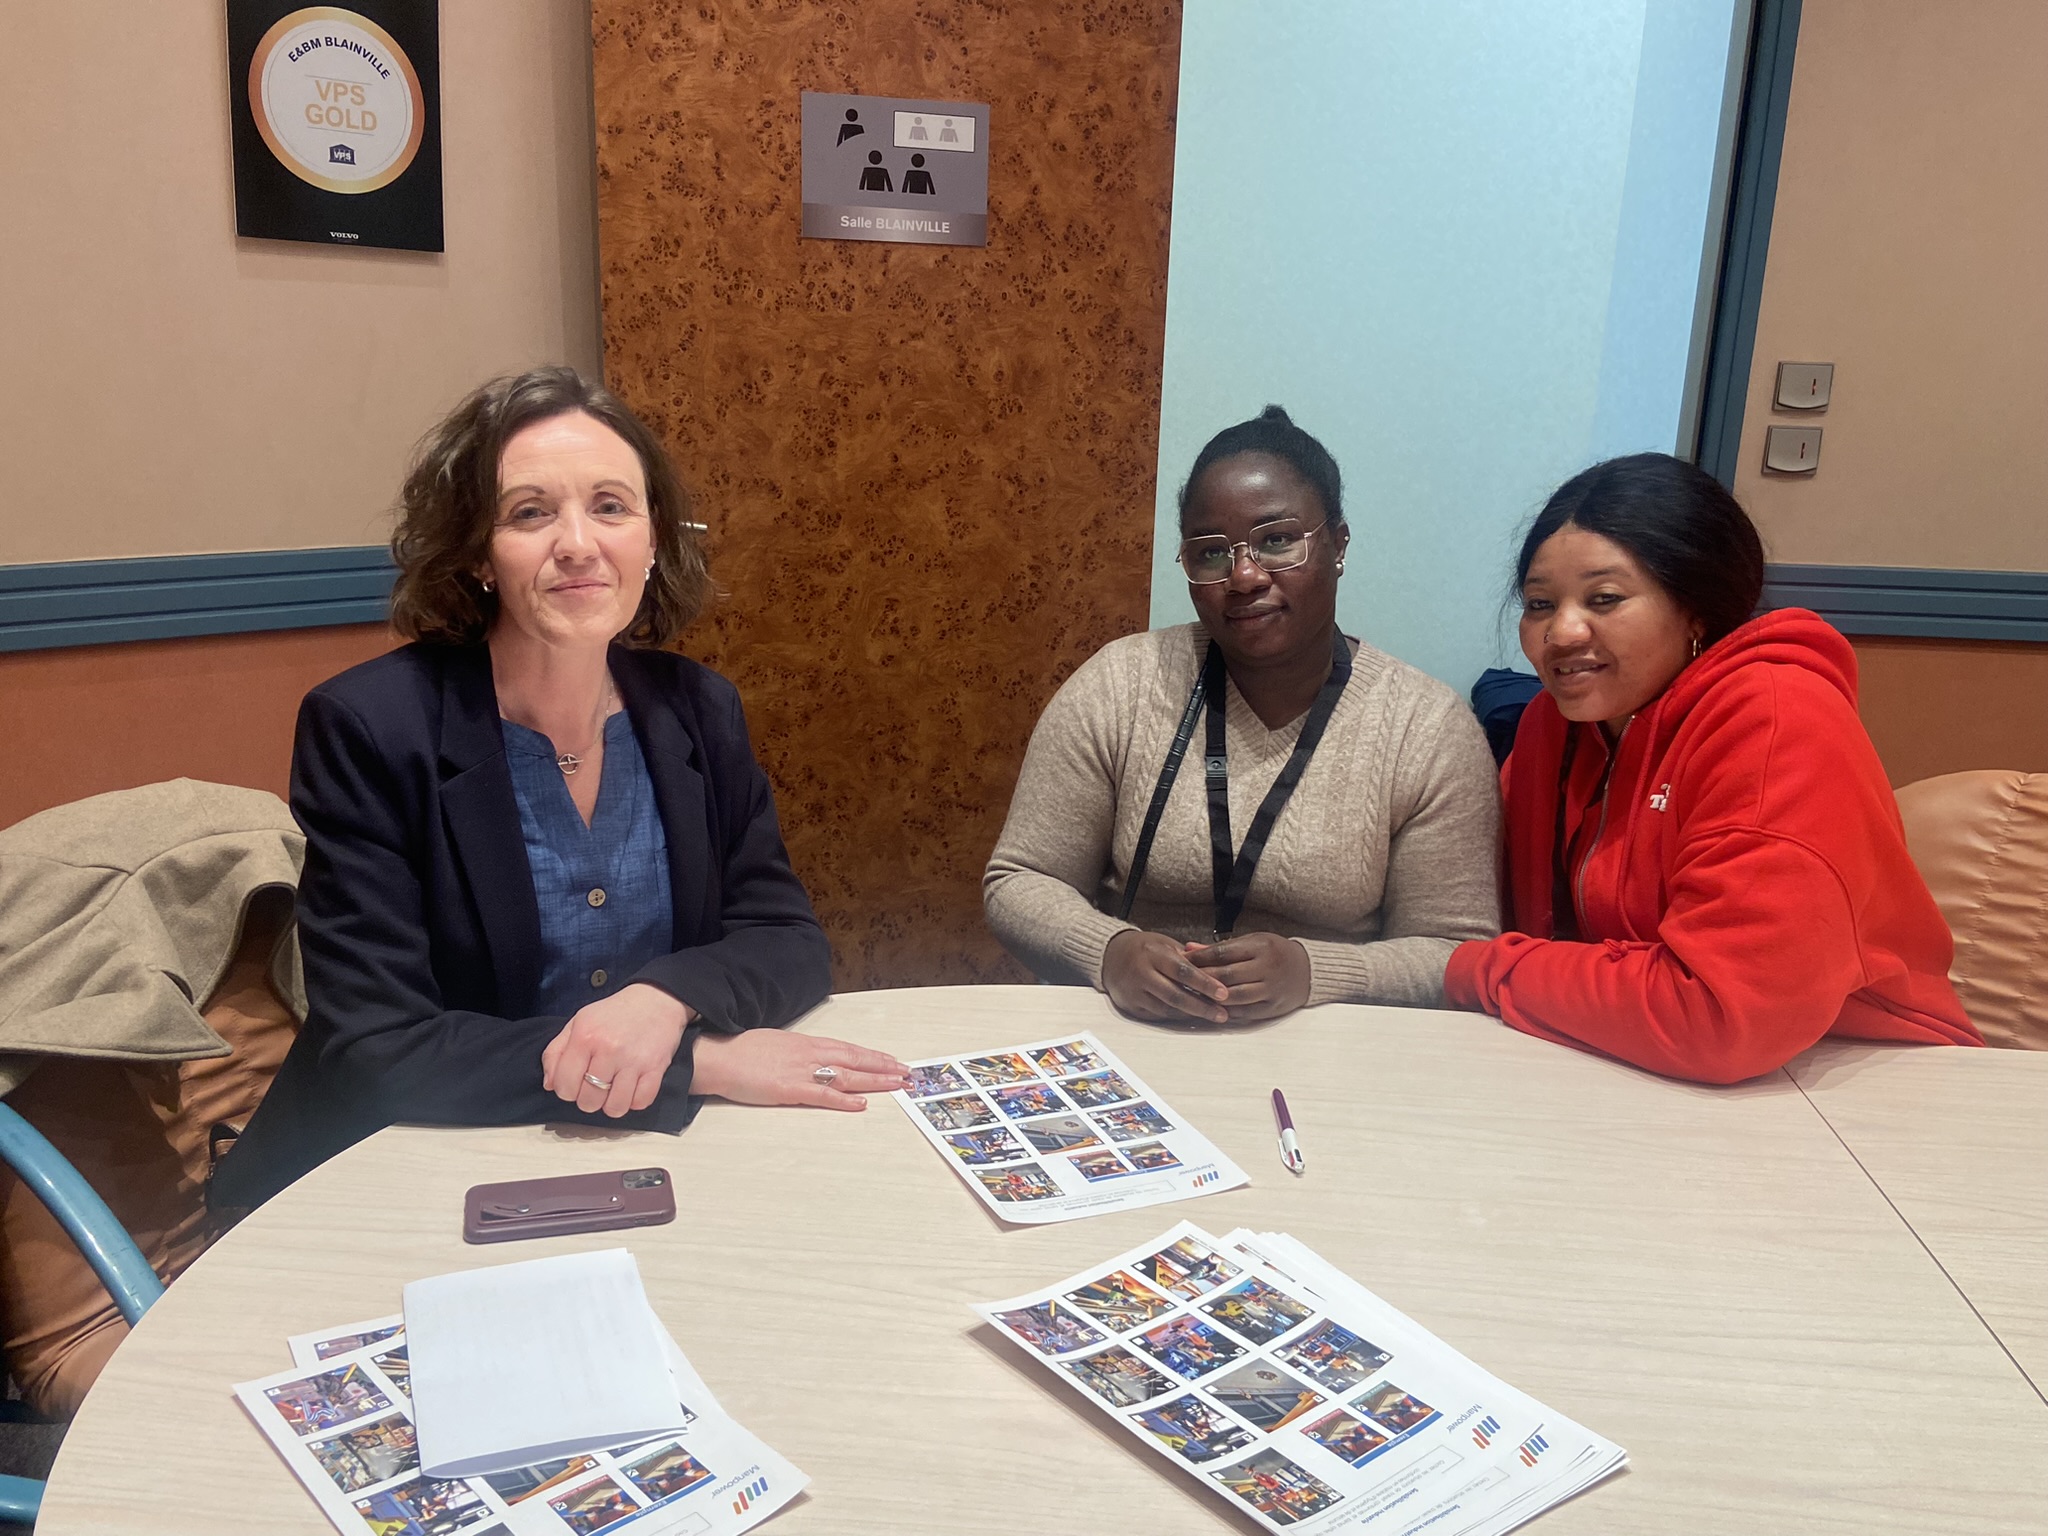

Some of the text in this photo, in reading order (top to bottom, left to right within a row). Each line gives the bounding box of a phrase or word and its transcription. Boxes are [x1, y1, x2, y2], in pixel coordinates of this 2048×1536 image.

[288, 36, 391, 80] E&BM BLAINVILLE
[315, 79, 366, 106] VPS
[304, 103, 378, 132] GOLD
[333, 151, 352, 161] VPS
[329, 231, 359, 240] VOLVO
[840, 215, 950, 234] Salle BLAINVILLE
[1446, 1403, 1483, 1434] Manpower
[711, 1464, 761, 1500] Manpower
[635, 1500, 667, 1518] Exemple
